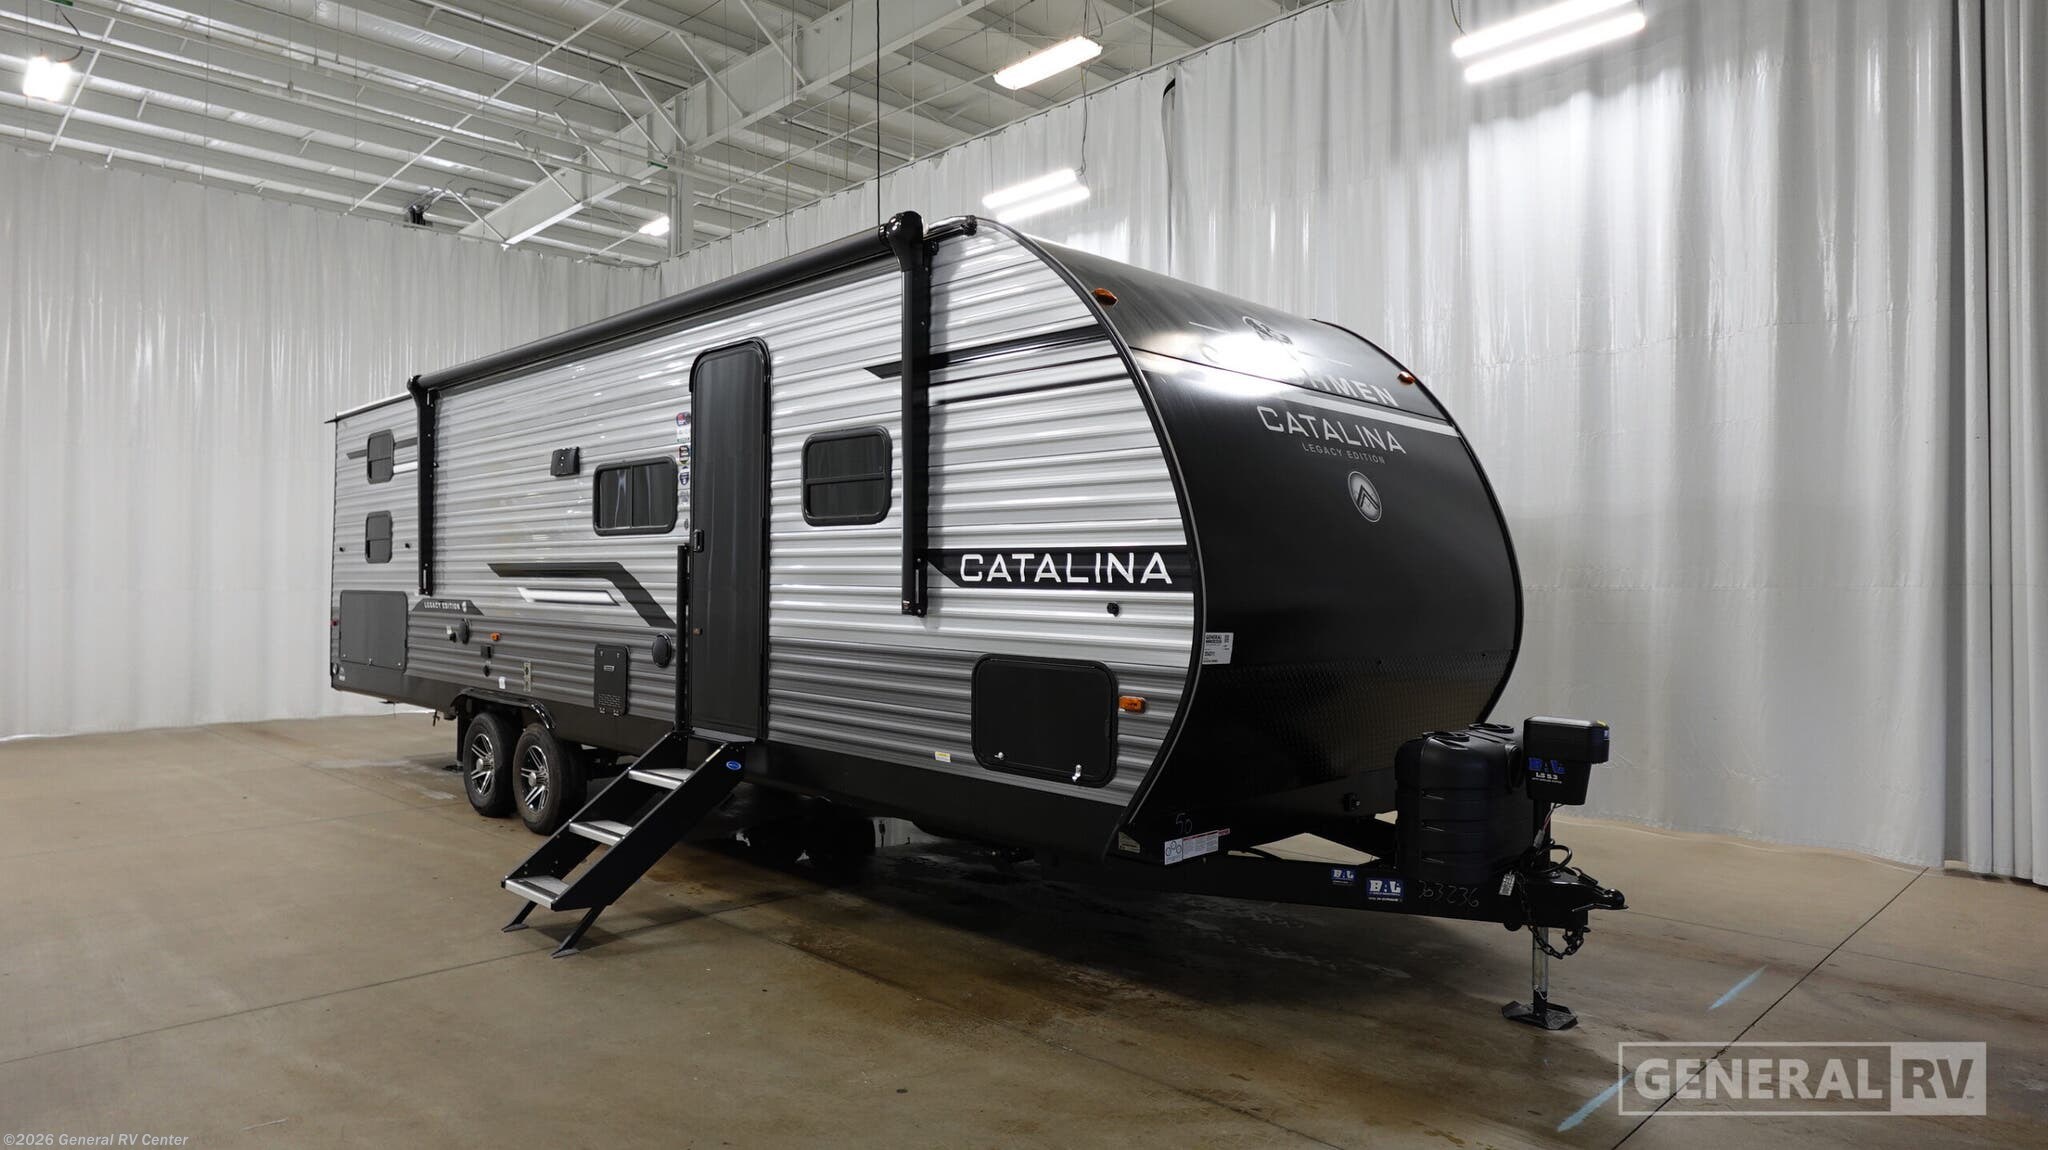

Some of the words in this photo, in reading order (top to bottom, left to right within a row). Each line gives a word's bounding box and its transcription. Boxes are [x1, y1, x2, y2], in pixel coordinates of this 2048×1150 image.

[1257, 405, 1407, 454] CATALINA
[1302, 441, 1343, 457] LEGACY
[1347, 450, 1386, 465] EDITION
[960, 552, 1173, 584] CATALINA
